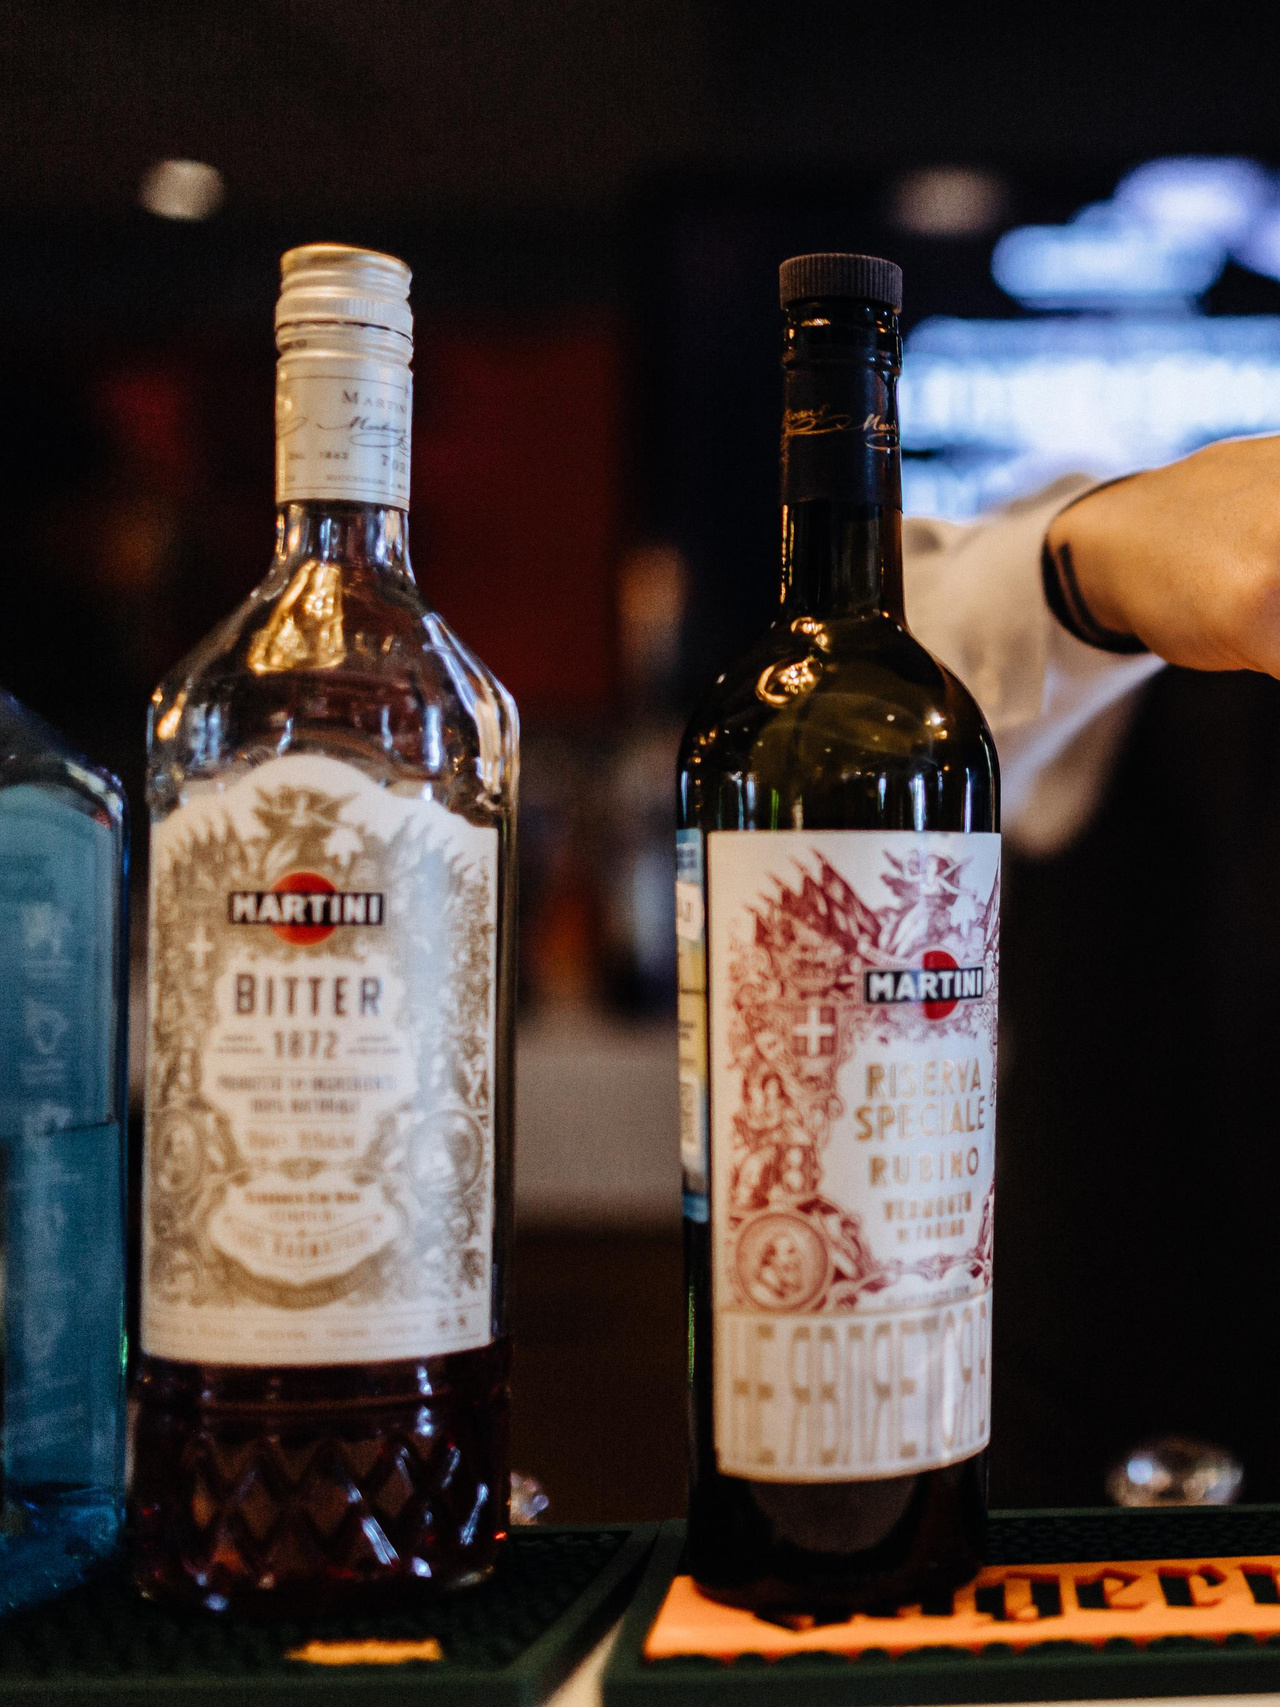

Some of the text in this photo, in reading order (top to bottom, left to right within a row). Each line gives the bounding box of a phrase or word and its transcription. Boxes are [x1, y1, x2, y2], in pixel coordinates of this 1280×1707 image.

[232, 894, 381, 923] MARTINI
[234, 973, 382, 1016] BITTER
[868, 969, 983, 1001] MARTINI
[274, 1030, 338, 1060] 1872
[865, 1058, 981, 1100] RISERVA
[854, 1096, 985, 1142] SPECIALE
[869, 1147, 979, 1187] RUBINO
